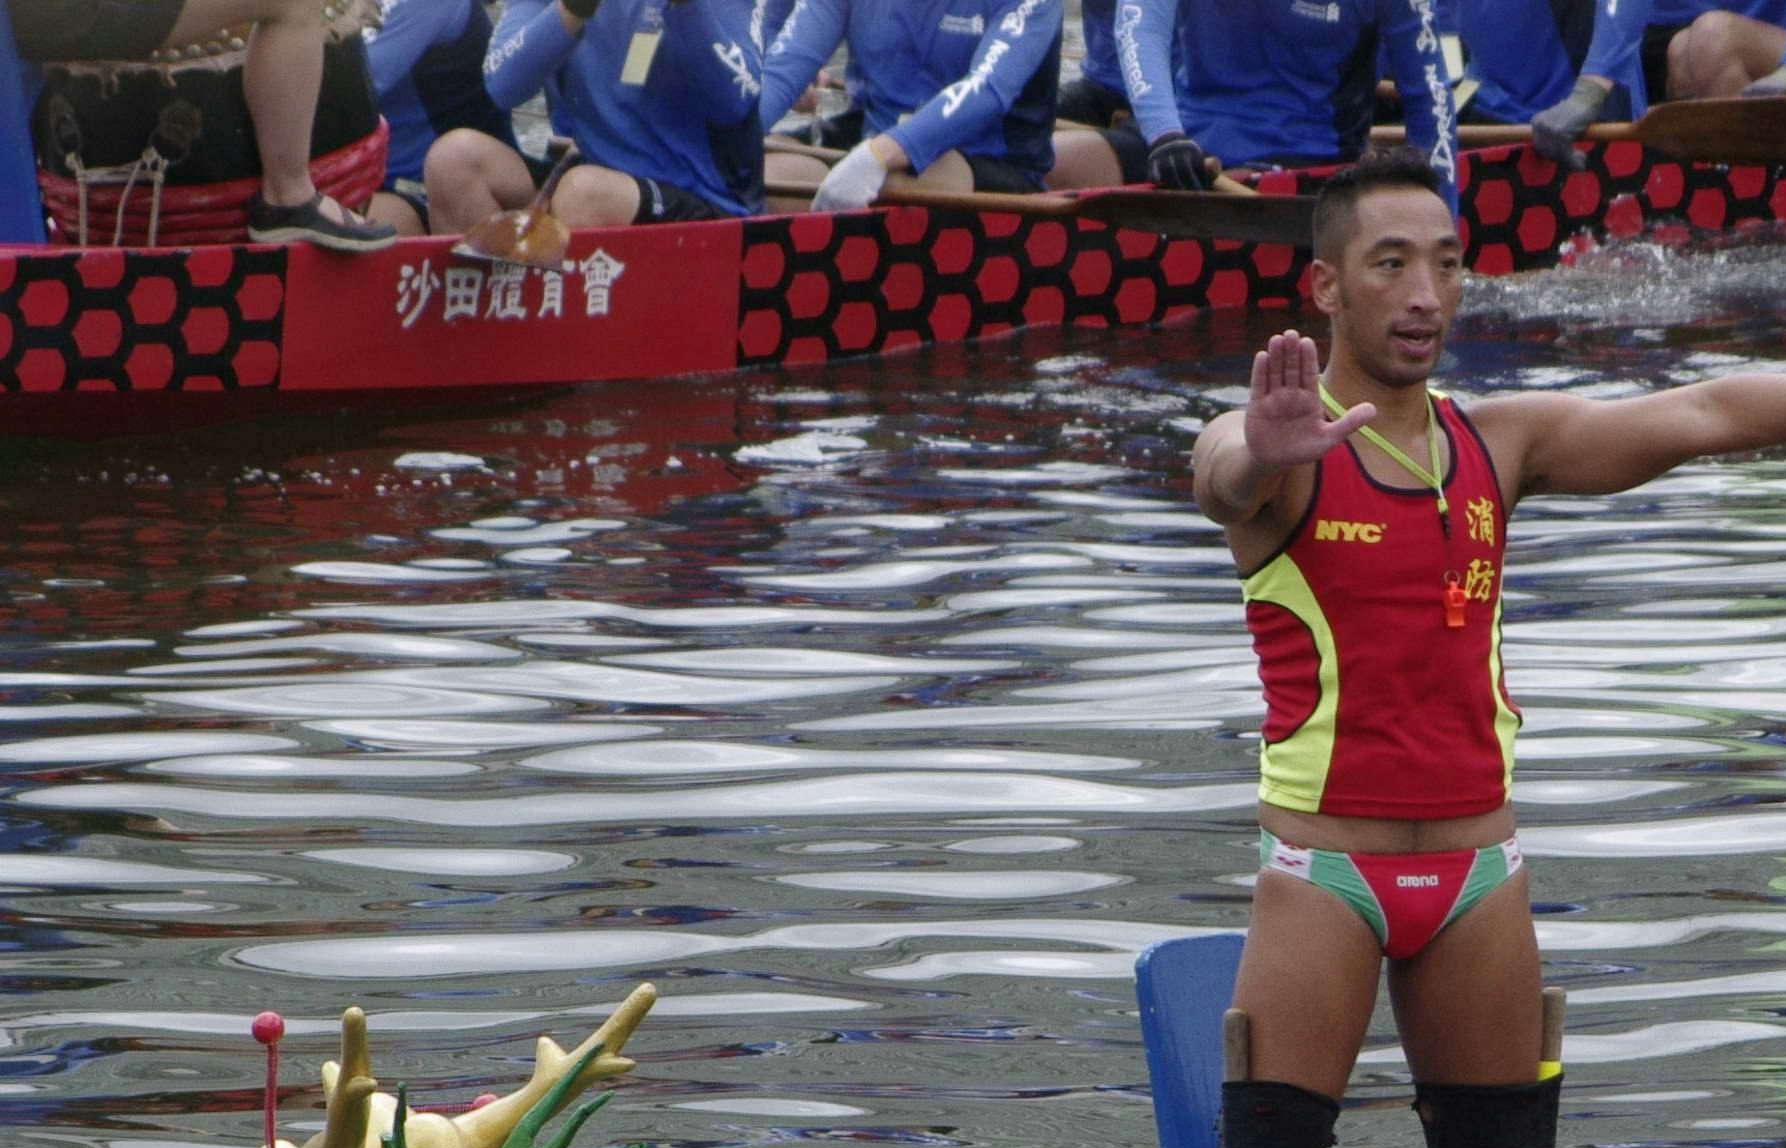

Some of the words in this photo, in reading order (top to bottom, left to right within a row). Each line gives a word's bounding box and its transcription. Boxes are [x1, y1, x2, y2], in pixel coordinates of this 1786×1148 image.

[396, 248, 625, 328] 沙田體育會
[1314, 519, 1384, 544] NYC
[1464, 496, 1495, 602] 消防
[1396, 875, 1439, 887] arena
